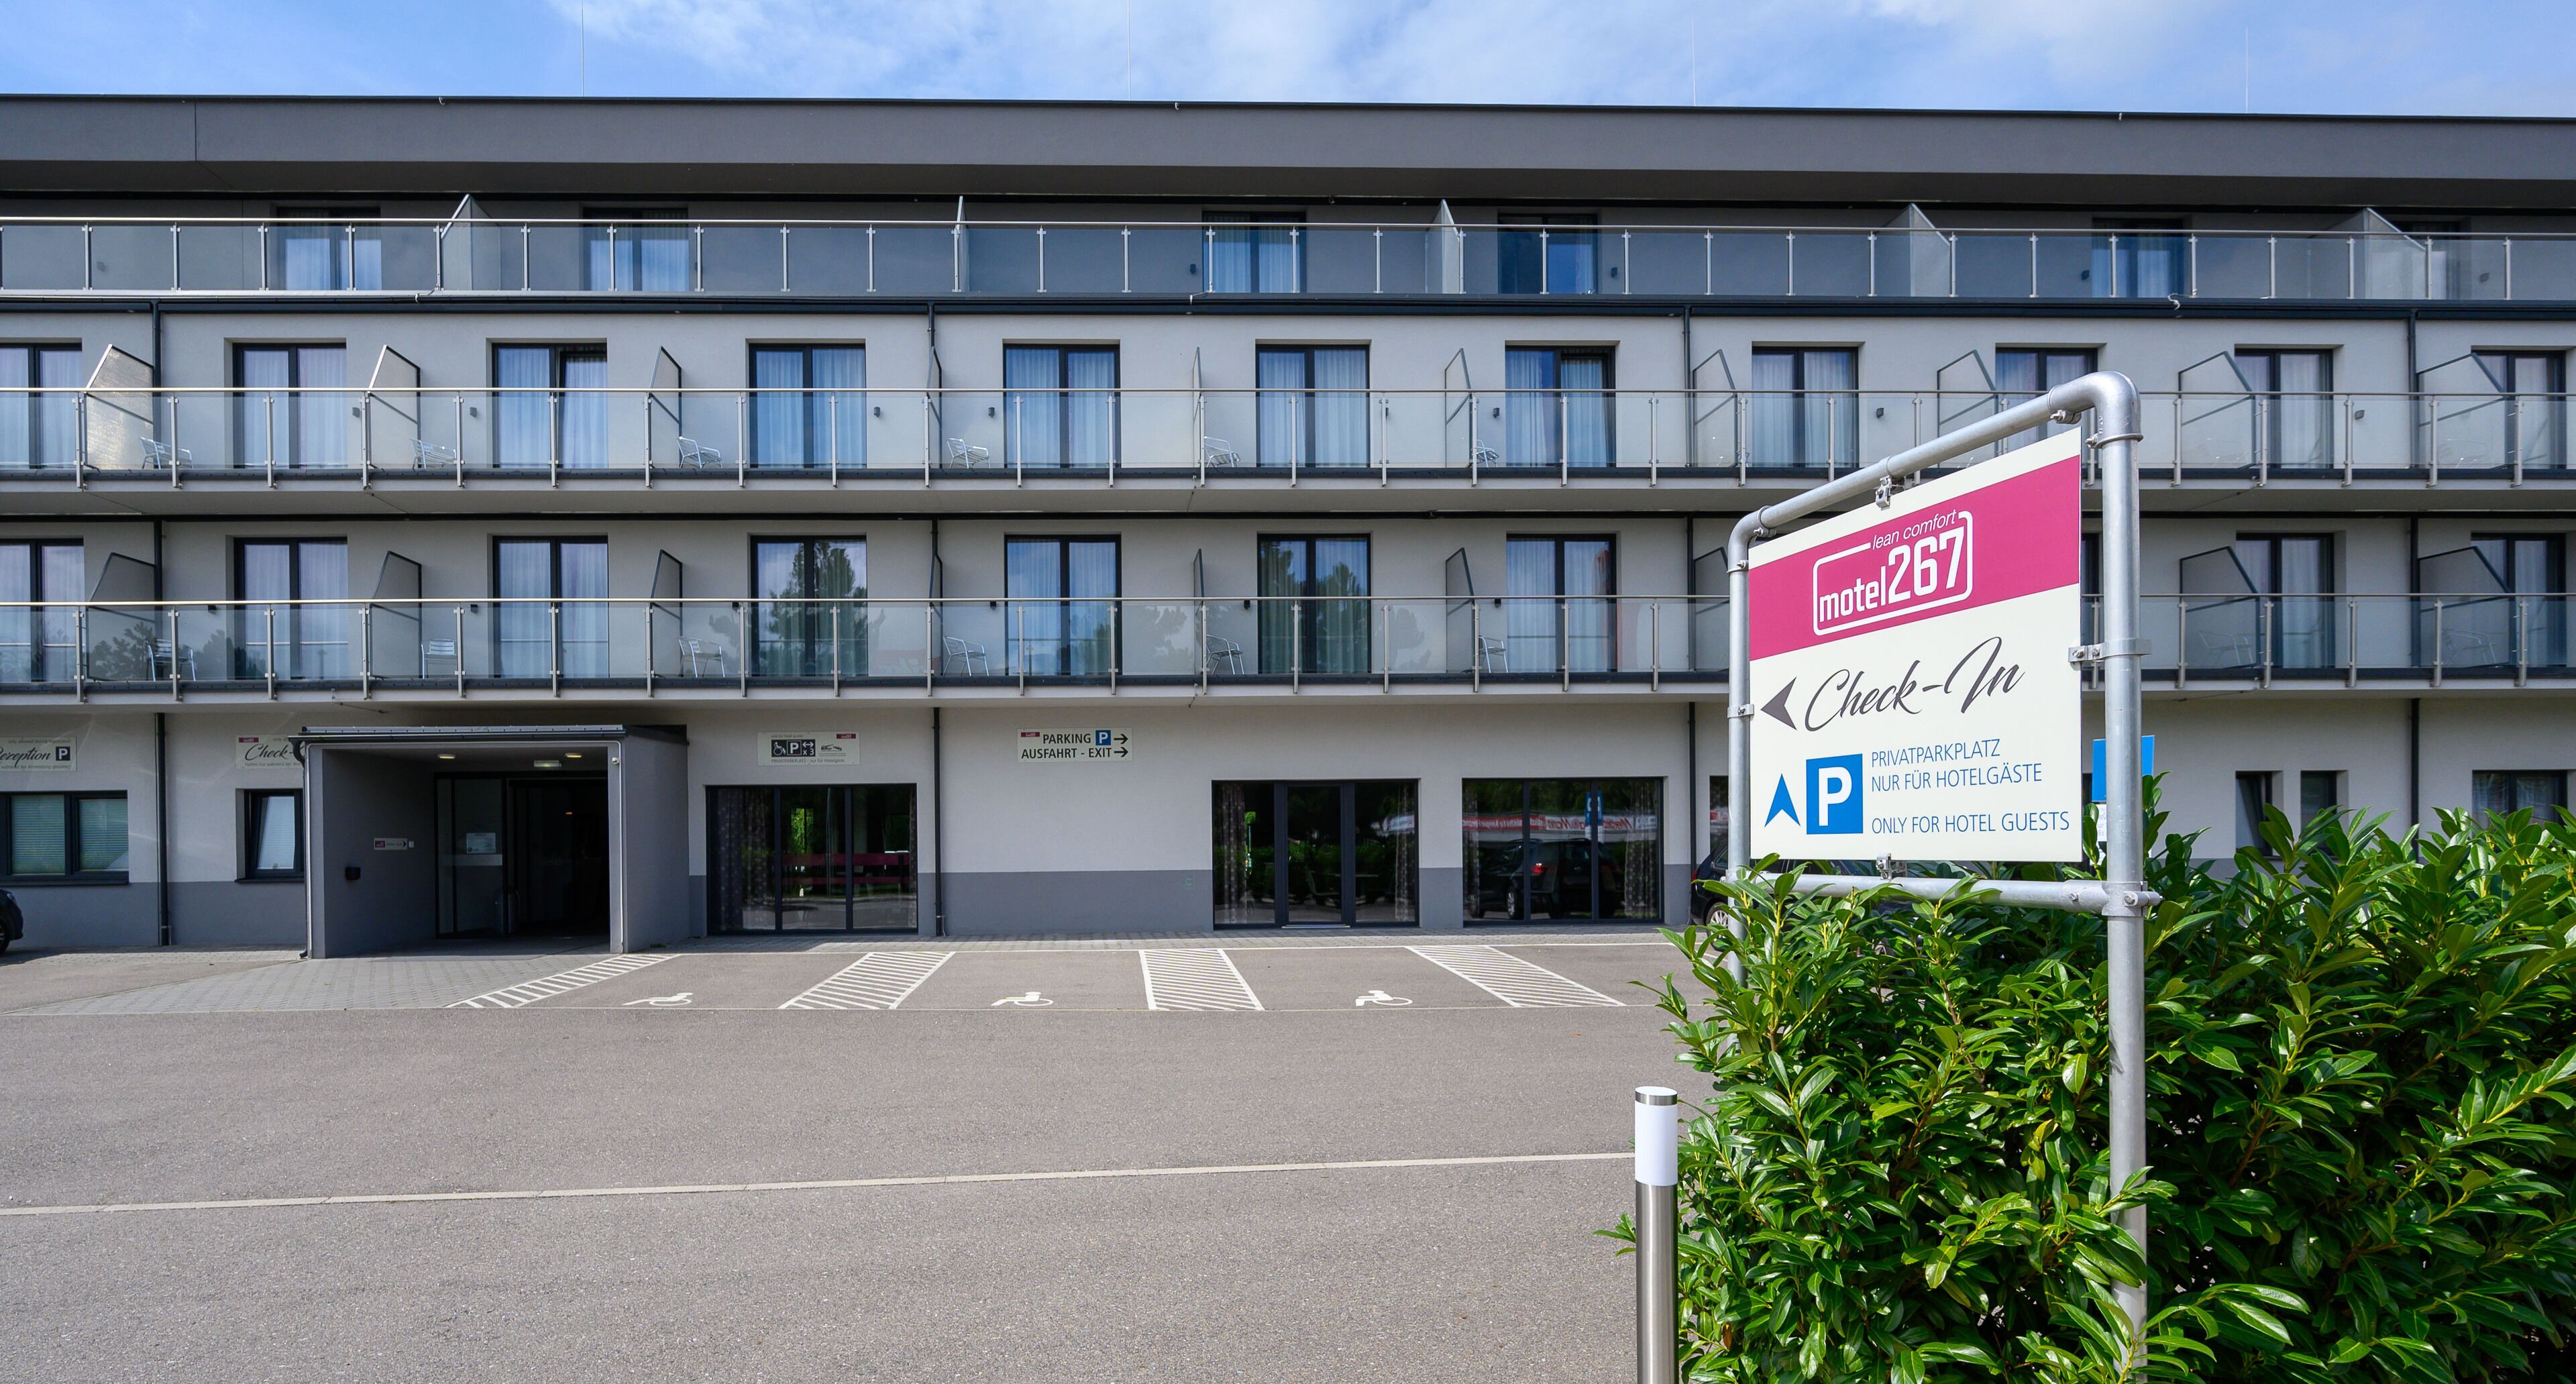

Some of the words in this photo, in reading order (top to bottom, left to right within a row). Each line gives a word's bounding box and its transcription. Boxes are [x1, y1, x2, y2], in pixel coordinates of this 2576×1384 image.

[1872, 531, 1900, 550] lean
[1903, 509, 1957, 539] comfort
[1805, 636, 2026, 732] Check-In
[1042, 733, 1091, 744] PARKING
[1099, 732, 1108, 744] P
[58, 747, 68, 760] P
[1021, 748, 1077, 759] AUSFAHRT
[1088, 747, 1112, 758] EXIT
[1872, 739, 2001, 768] PRIVATPARKPLATZ
[1872, 774, 1900, 792] NUR
[1905, 769, 1931, 790] FÜR
[1937, 762, 2043, 788] HOTELGÄSTE
[1819, 766, 1853, 827] P
[1872, 816, 1907, 834] ONLY
[1912, 816, 1939, 833] FOR
[1945, 813, 1996, 833] HOTEL
[2001, 810, 2070, 832] GUESTS
